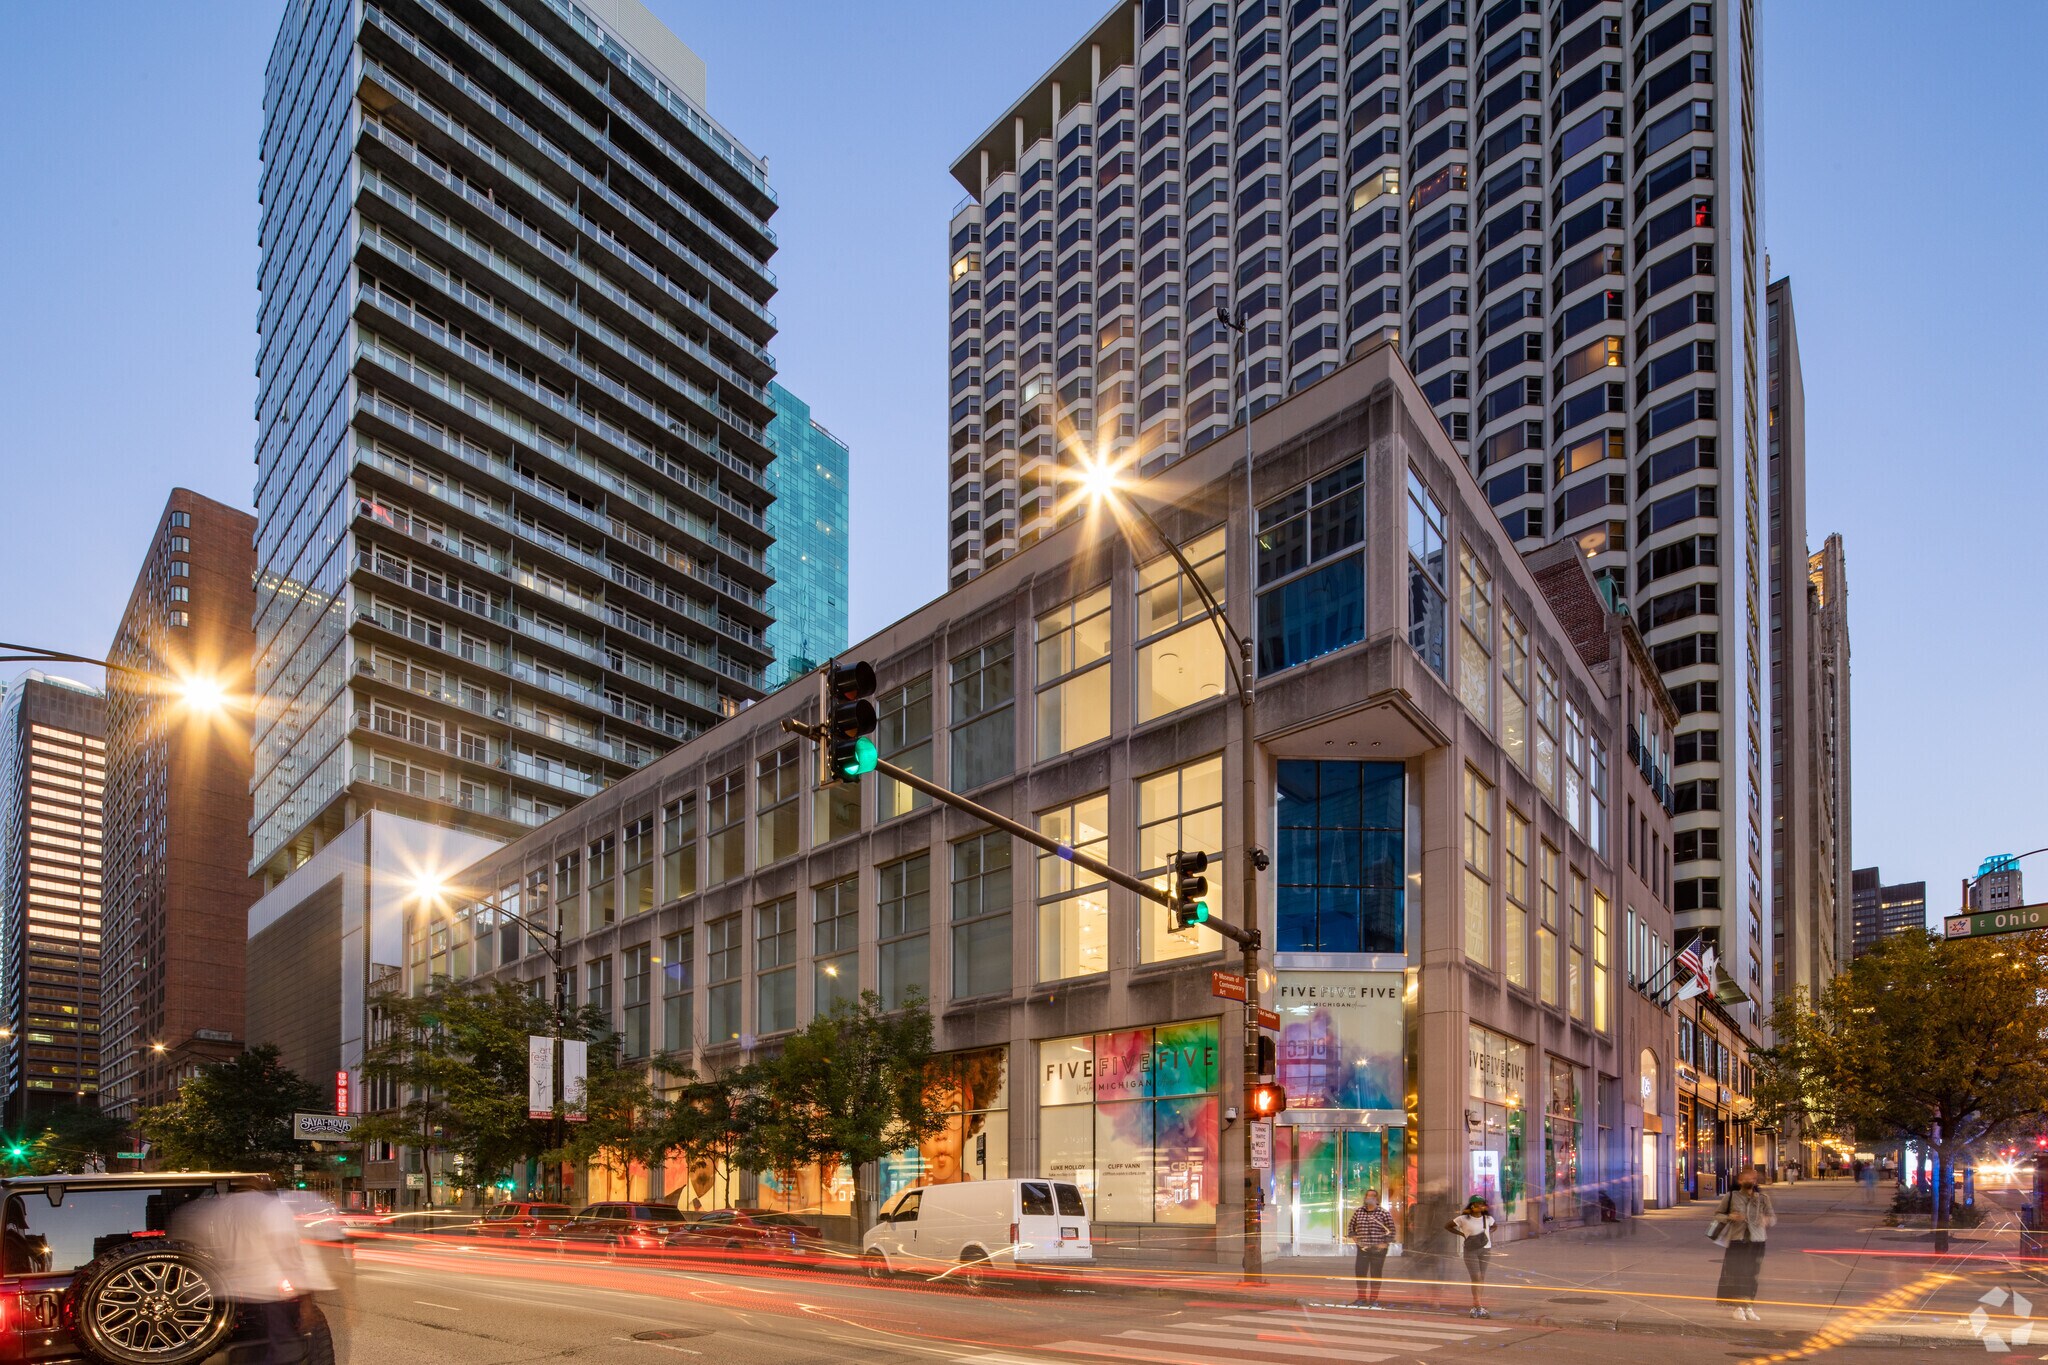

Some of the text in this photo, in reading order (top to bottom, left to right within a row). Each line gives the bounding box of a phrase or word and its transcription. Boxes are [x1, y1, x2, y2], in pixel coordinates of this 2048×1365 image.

[1980, 912, 2040, 928] E Ohio
[1219, 973, 1235, 982] Museum
[1219, 981, 1245, 993] Contemporary
[1281, 986, 1396, 999] FIVE FIVE FIVE
[531, 1052, 549, 1064] fest
[1046, 1047, 1213, 1081] FIVE FIVE FIVE
[1469, 1050, 1484, 1071] IVE
[1506, 1063, 1524, 1082] FIVE
[1098, 1080, 1152, 1091] MICHIGAN
[300, 1117, 352, 1132] SAYAT-NOVA
[1170, 1161, 1204, 1172] CBRE
